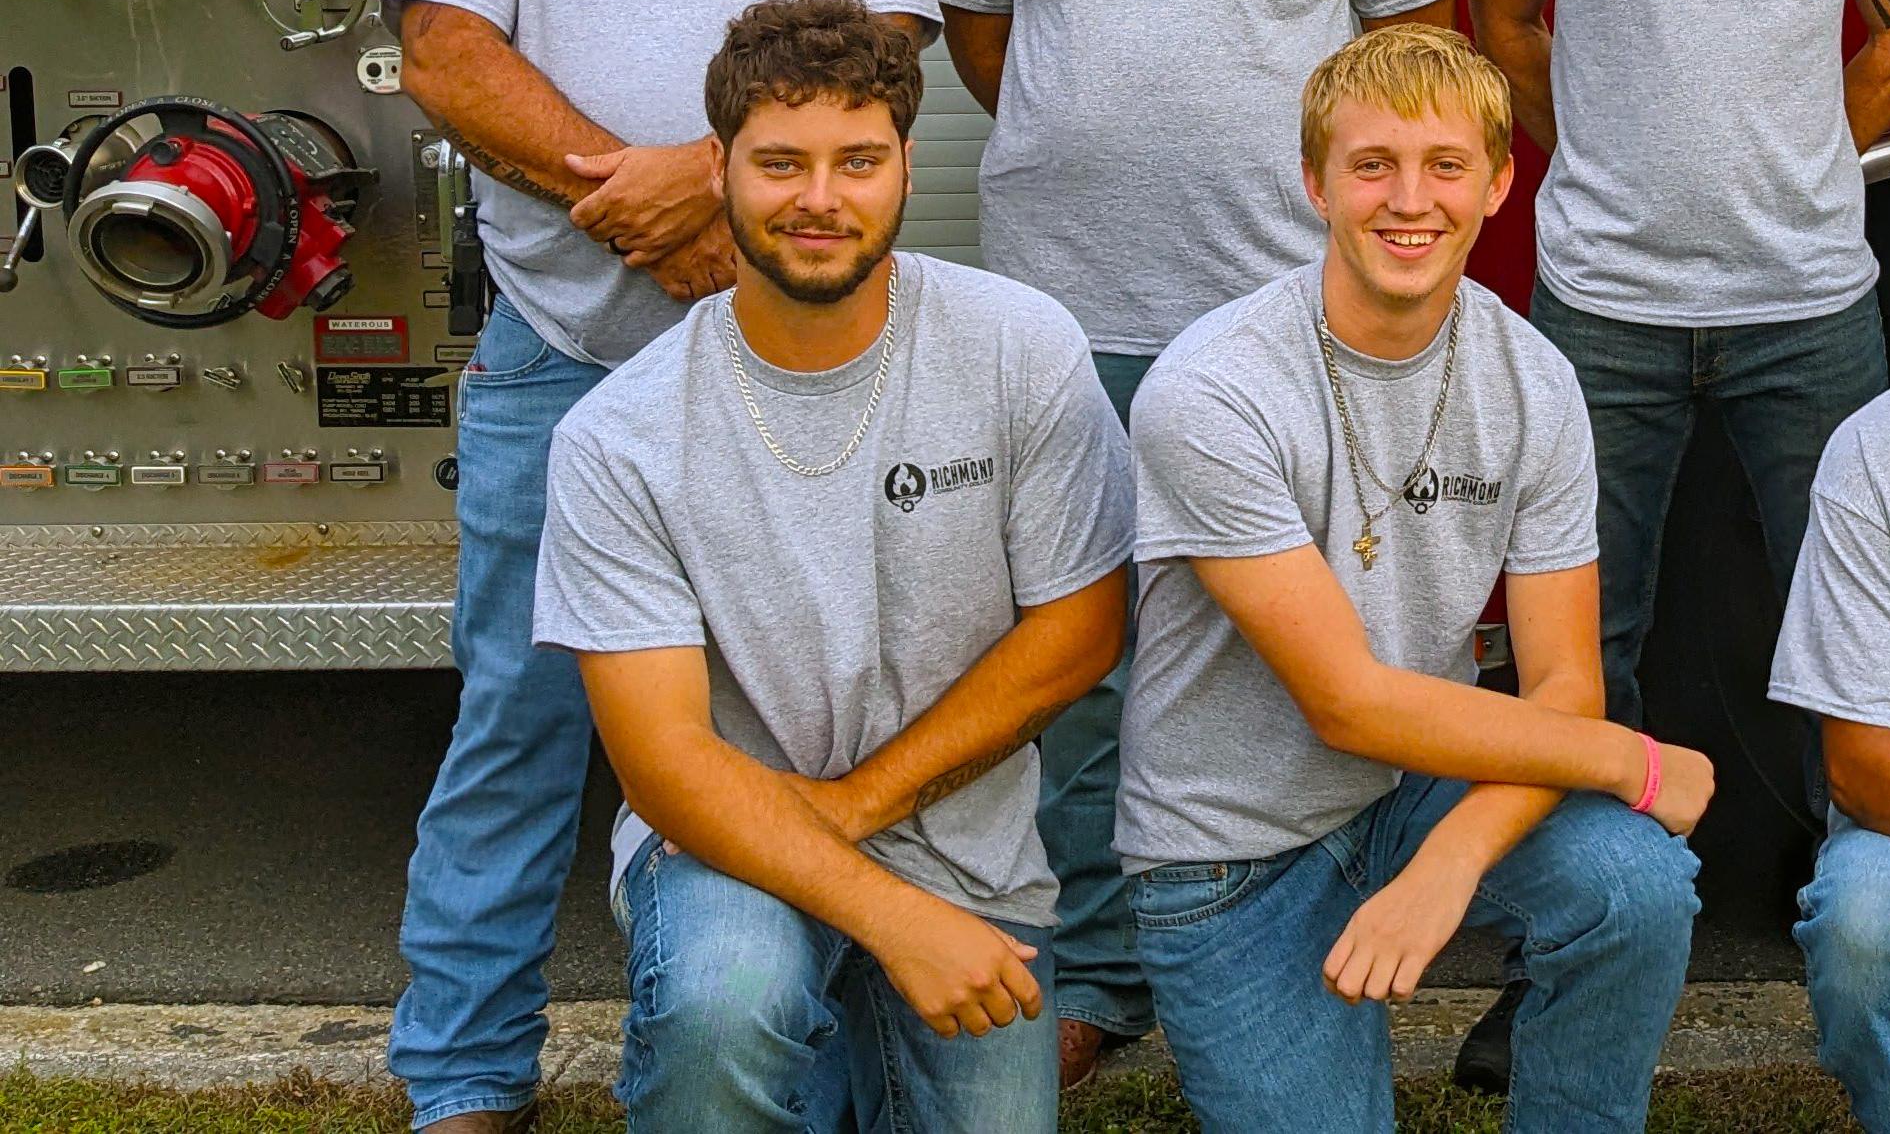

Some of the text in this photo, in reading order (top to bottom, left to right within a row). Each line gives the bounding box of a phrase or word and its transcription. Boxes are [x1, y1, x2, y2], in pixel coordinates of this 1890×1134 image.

[175, 96, 216, 108] CLOSE
[288, 210, 299, 244] OPEN
[930, 458, 994, 489] RICHMOND
[1442, 476, 1502, 500] RICHMOND
